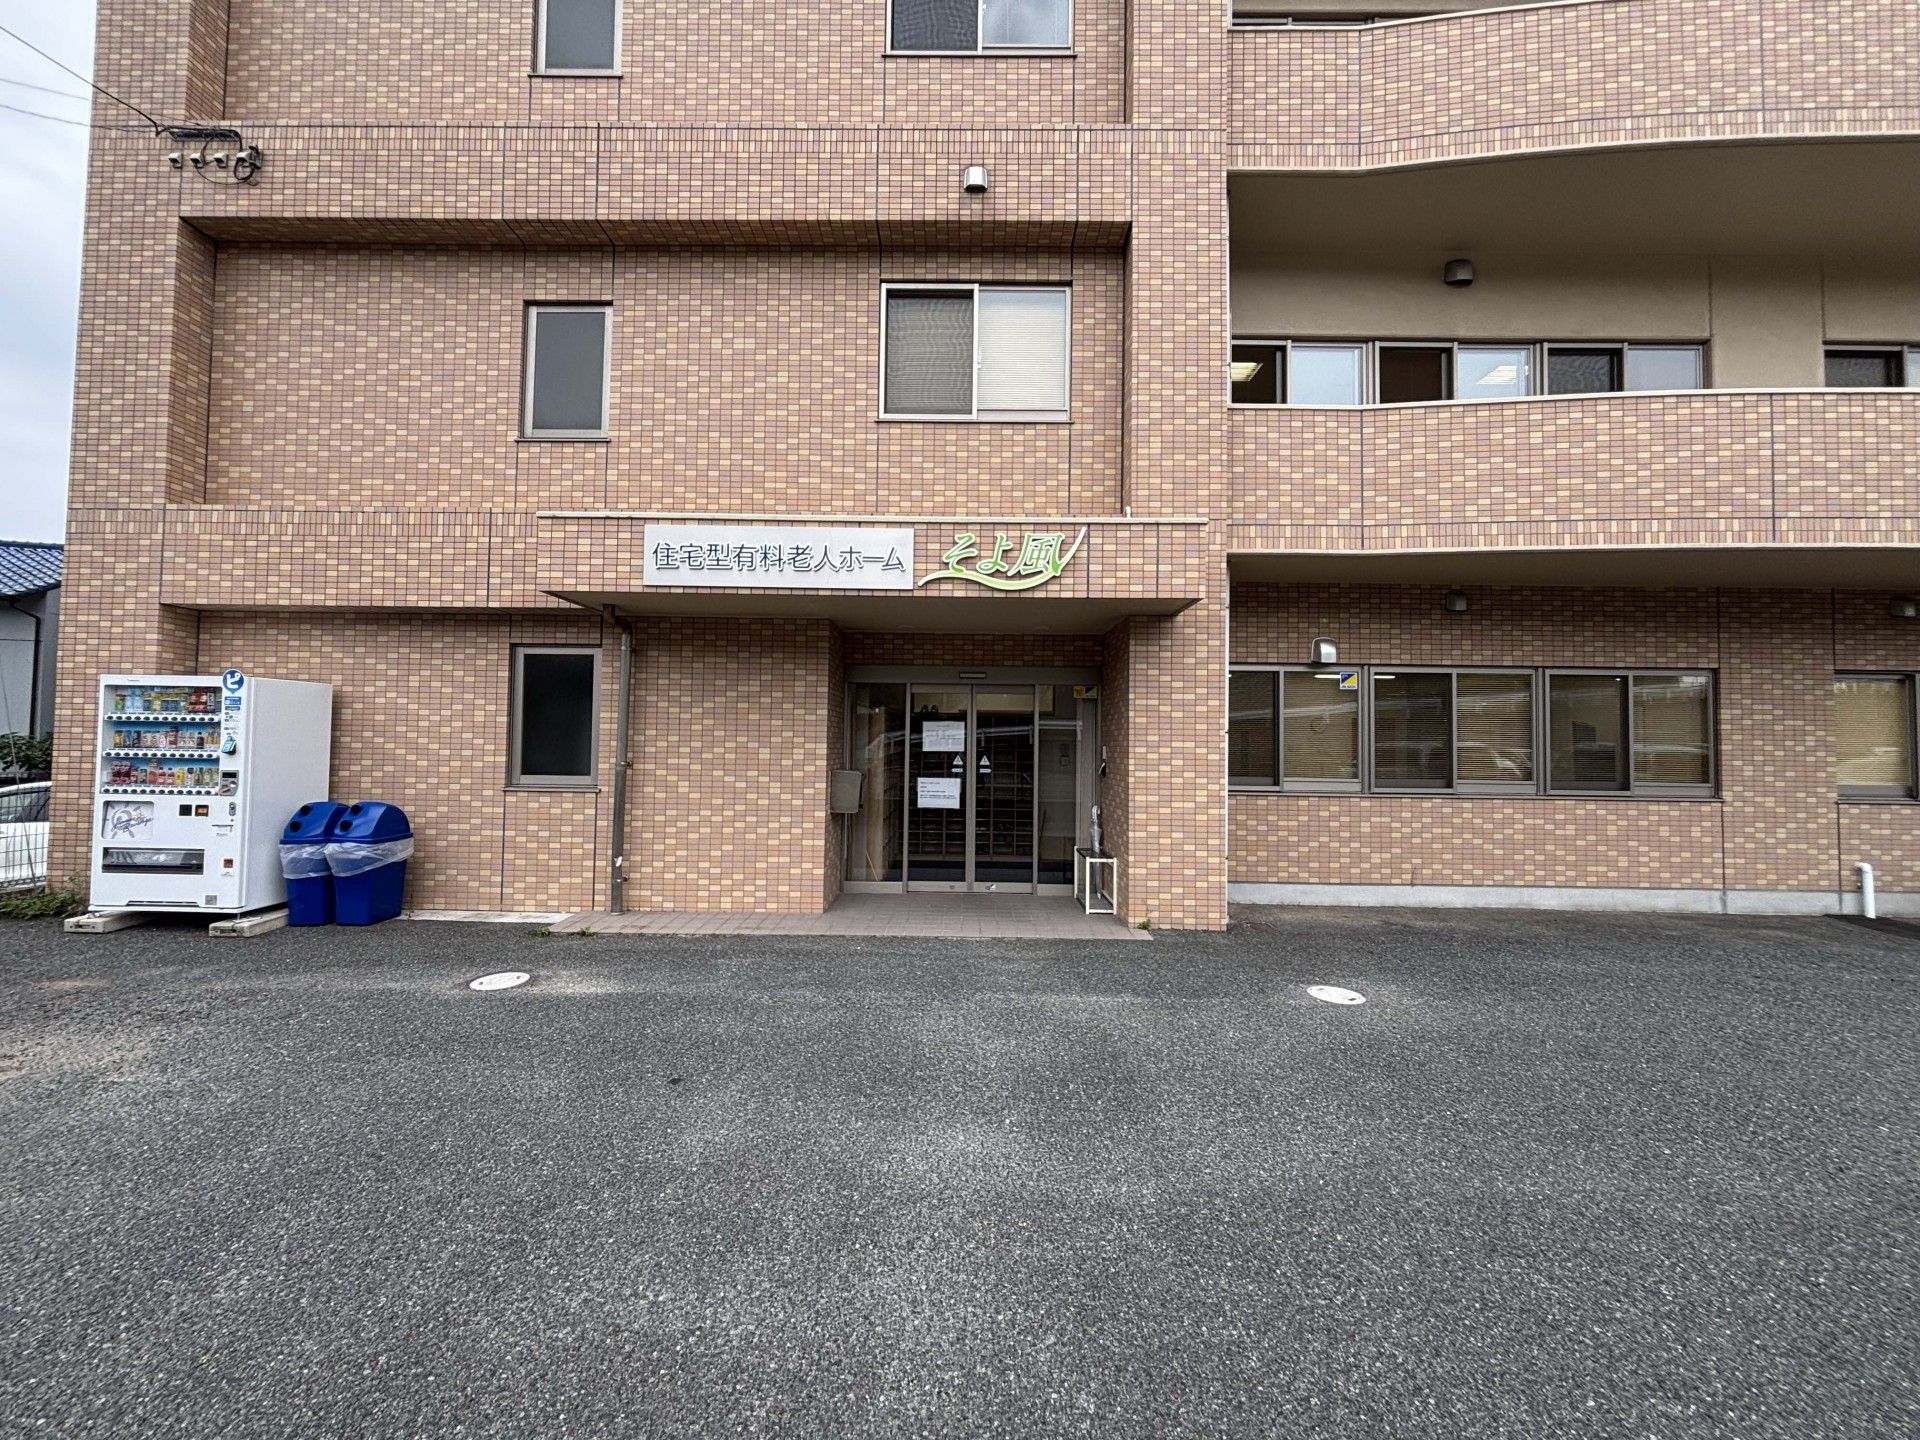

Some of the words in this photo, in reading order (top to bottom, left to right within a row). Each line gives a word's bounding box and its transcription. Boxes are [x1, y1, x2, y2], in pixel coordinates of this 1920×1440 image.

[652, 542, 906, 572] 住宅型有料老人ホーム
[943, 532, 1065, 577] そよ風
[226, 672, 242, 689] ピ
